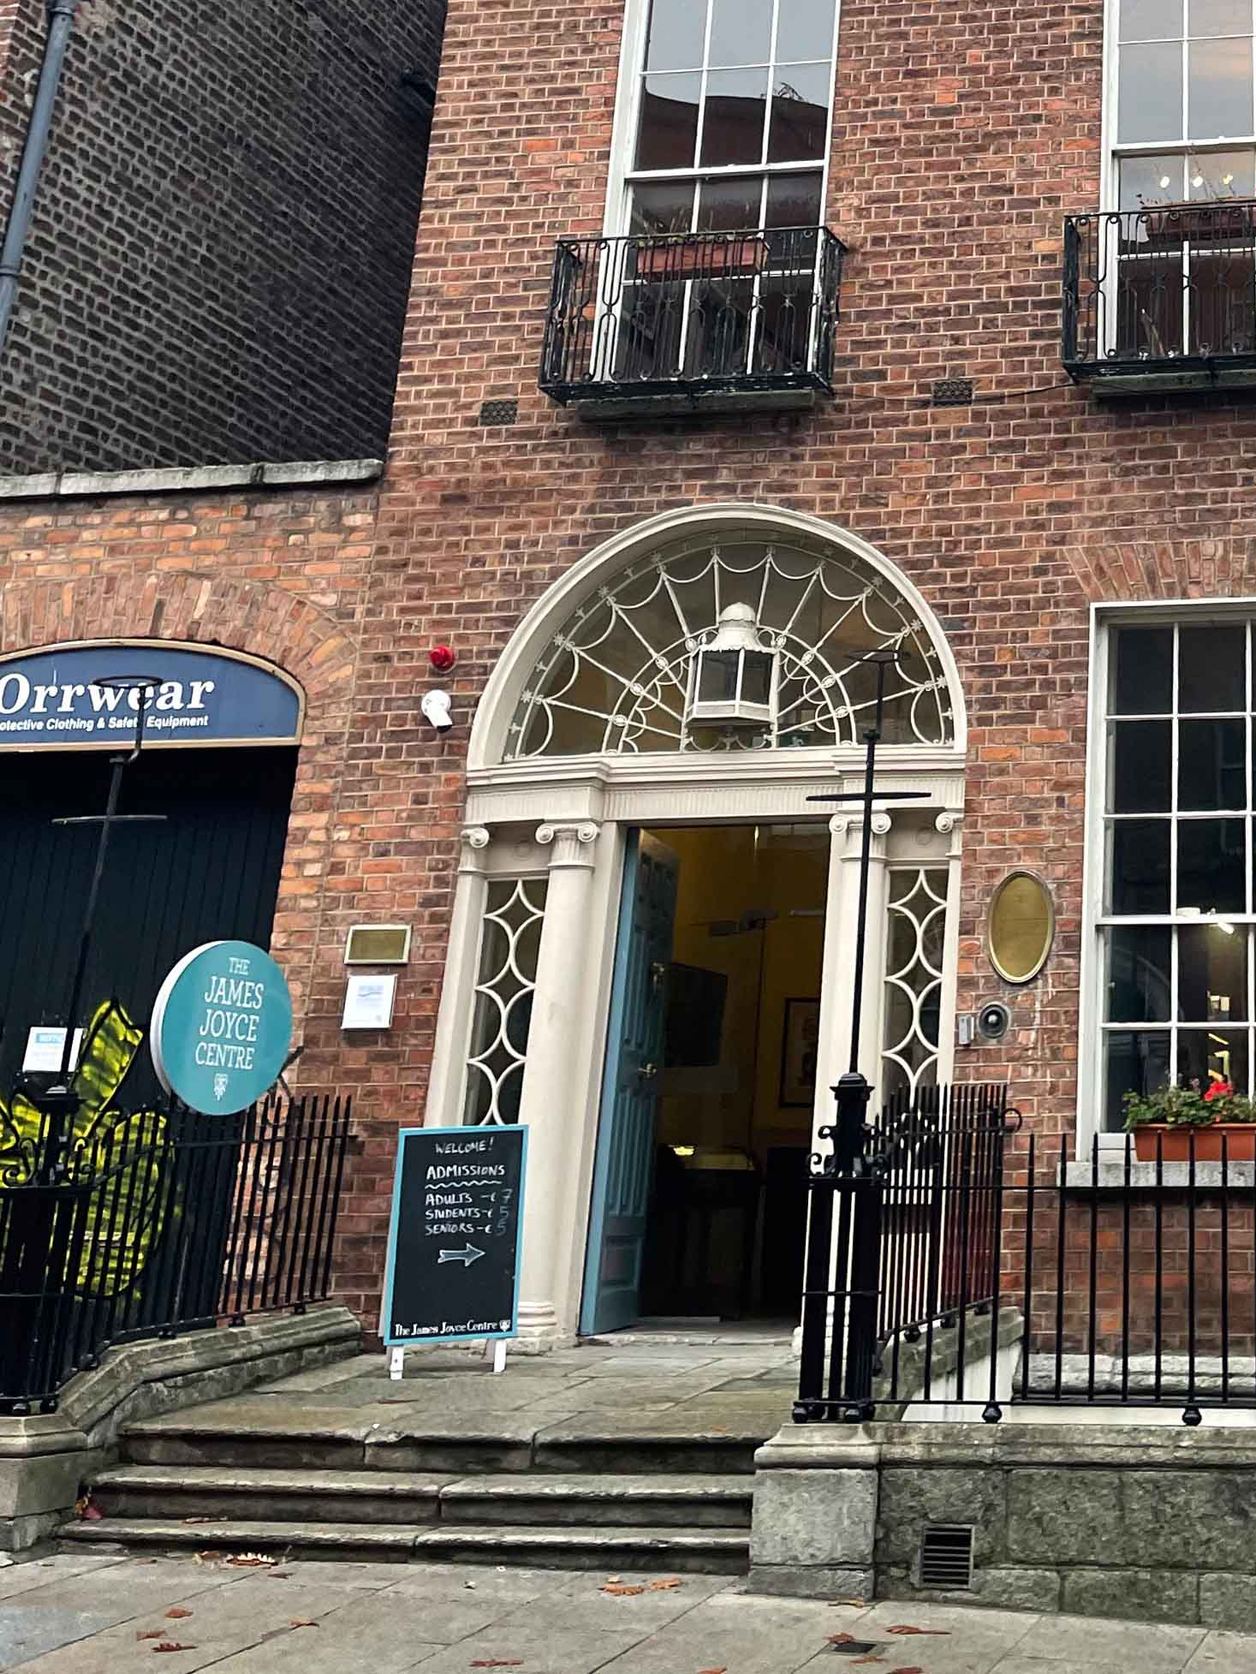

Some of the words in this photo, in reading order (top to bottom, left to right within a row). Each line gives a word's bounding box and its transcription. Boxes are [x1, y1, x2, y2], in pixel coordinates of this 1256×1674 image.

[0, 673, 215, 714] Orrwear
[46, 717, 94, 732] Clothing
[97, 717, 105, 729] &
[108, 716, 144, 729] Safet
[146, 715, 209, 730] Equipment
[228, 957, 251, 975] THE
[204, 975, 264, 1009] JAMES
[199, 1008, 260, 1042] JOYCE
[194, 1041, 255, 1070] CENTRE
[426, 1164, 506, 1180] ADMISSIONS
[425, 1192, 473, 1206] ADULTS
[425, 1222, 475, 1236] SENIORS
[395, 1323, 411, 1336] The
[411, 1323, 439, 1336] James
[440, 1321, 467, 1335] Joyce
[466, 1319, 498, 1332] Centre
